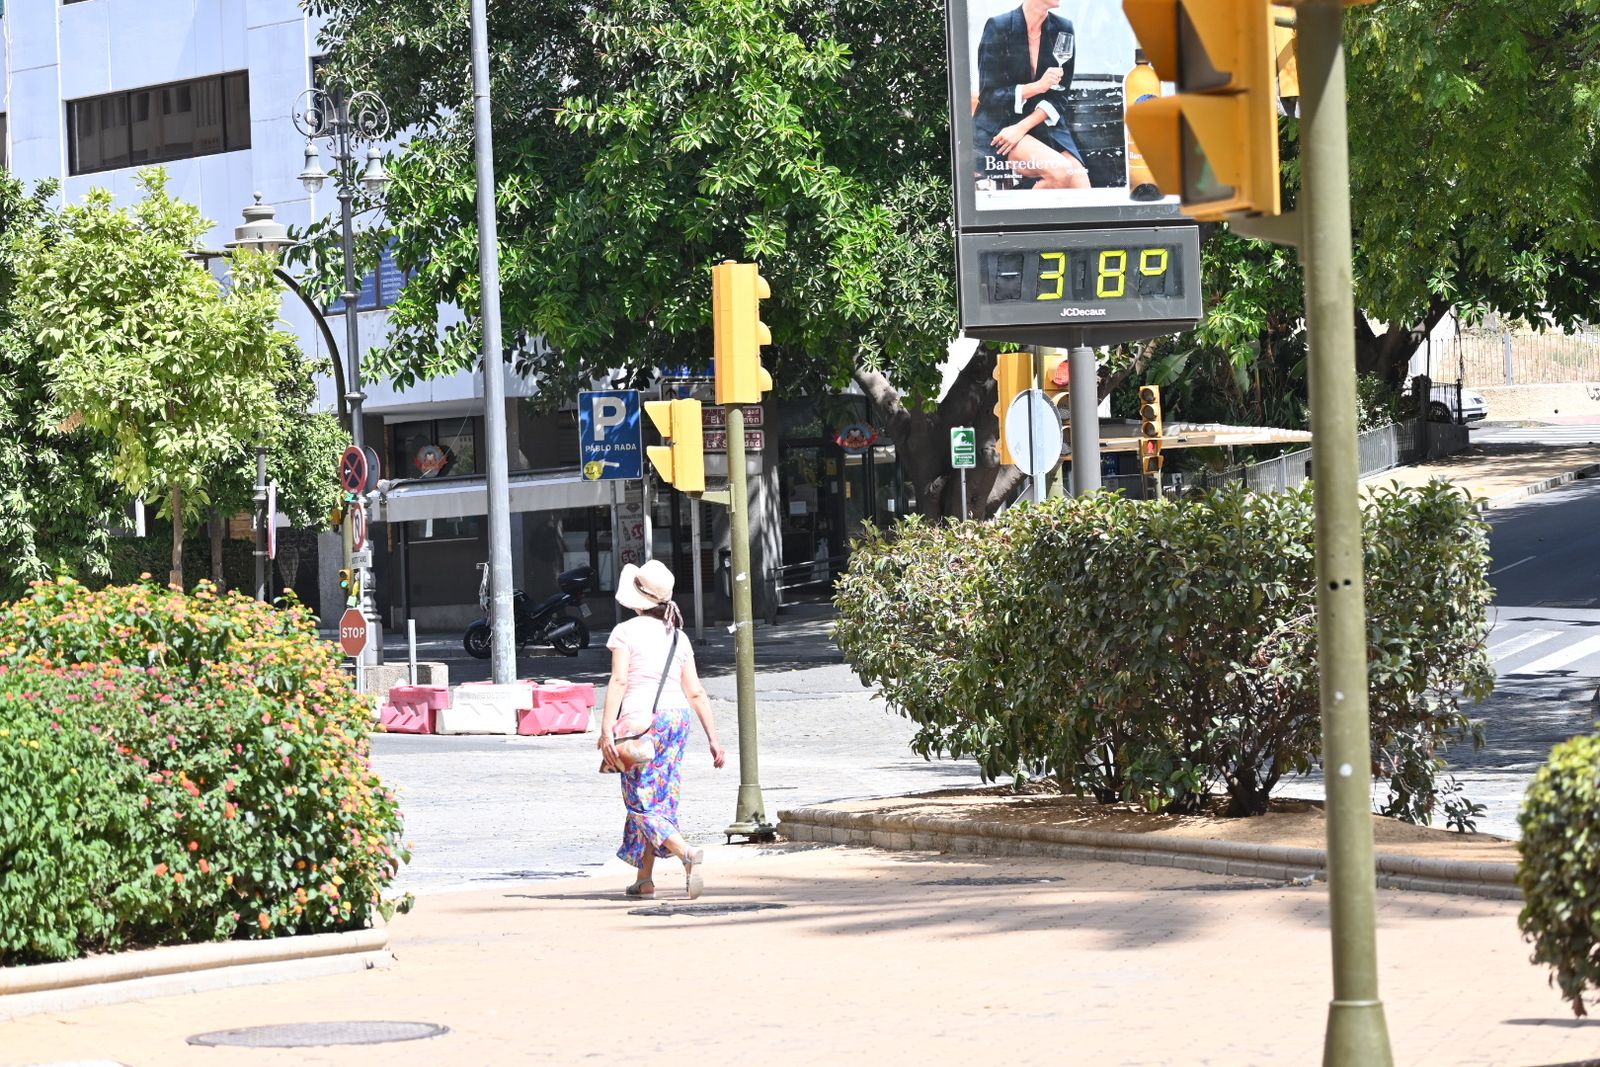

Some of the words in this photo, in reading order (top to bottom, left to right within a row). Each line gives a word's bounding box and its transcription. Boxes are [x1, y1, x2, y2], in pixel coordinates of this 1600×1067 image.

[1060, 307, 1107, 317] JCDecaux
[592, 396, 626, 441] P
[585, 444, 611, 452] PABLO
[614, 443, 637, 451] RADA
[342, 627, 365, 638] STOP
